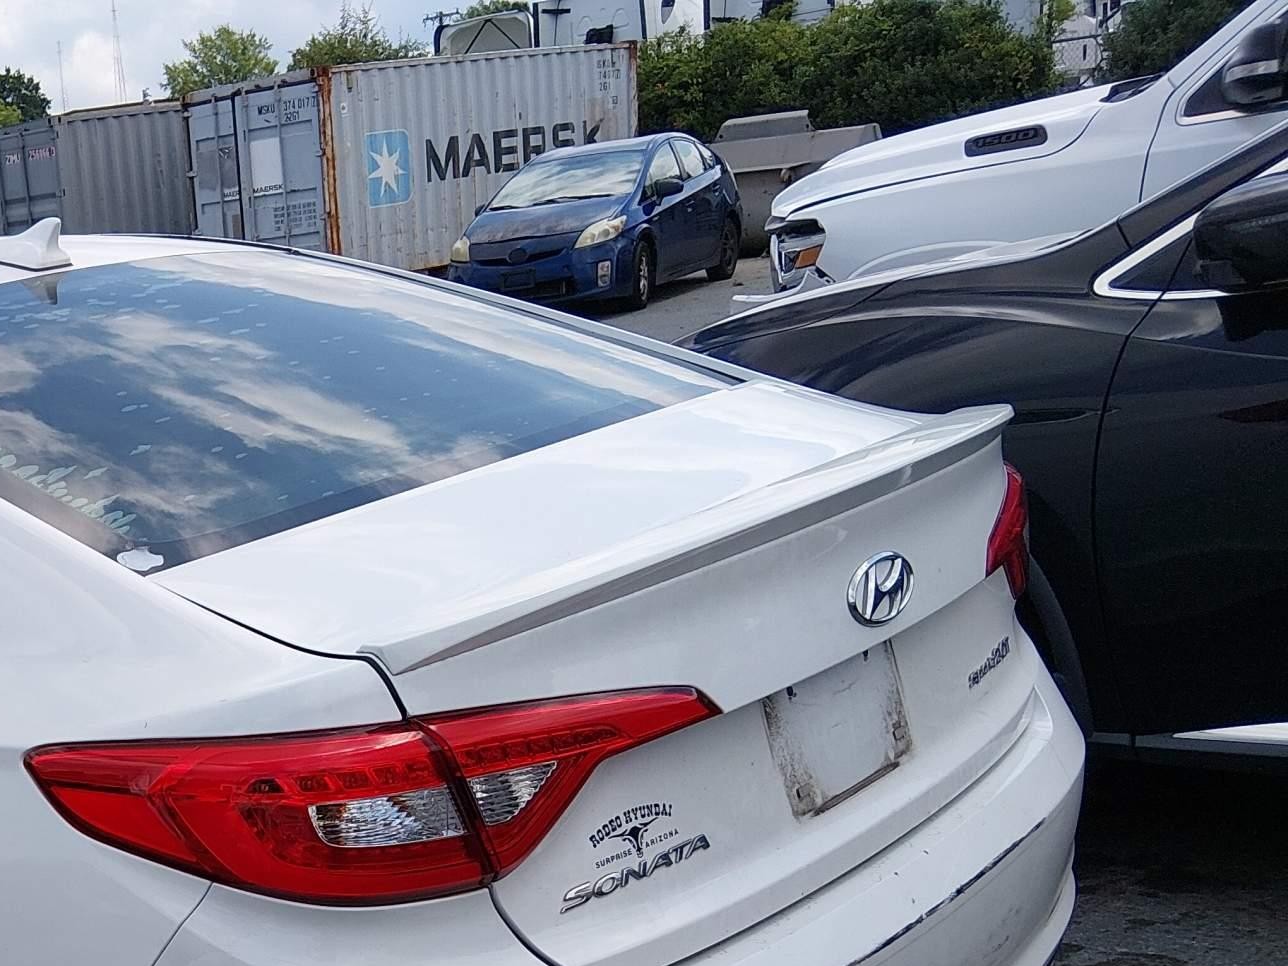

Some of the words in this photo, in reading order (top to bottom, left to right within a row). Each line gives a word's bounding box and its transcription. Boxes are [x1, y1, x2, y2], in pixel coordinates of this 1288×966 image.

[258, 104, 275, 116] MSKU
[425, 118, 605, 183] MAERSK
[975, 128, 1037, 149] 1500
[253, 184, 284, 194] MAERSK
[589, 815, 623, 848] RODEO
[623, 803, 673, 824] HYUNDAI
[595, 848, 633, 869] SURPRISE
[645, 828, 679, 848] ARIZONA
[560, 834, 711, 914] SONATA
